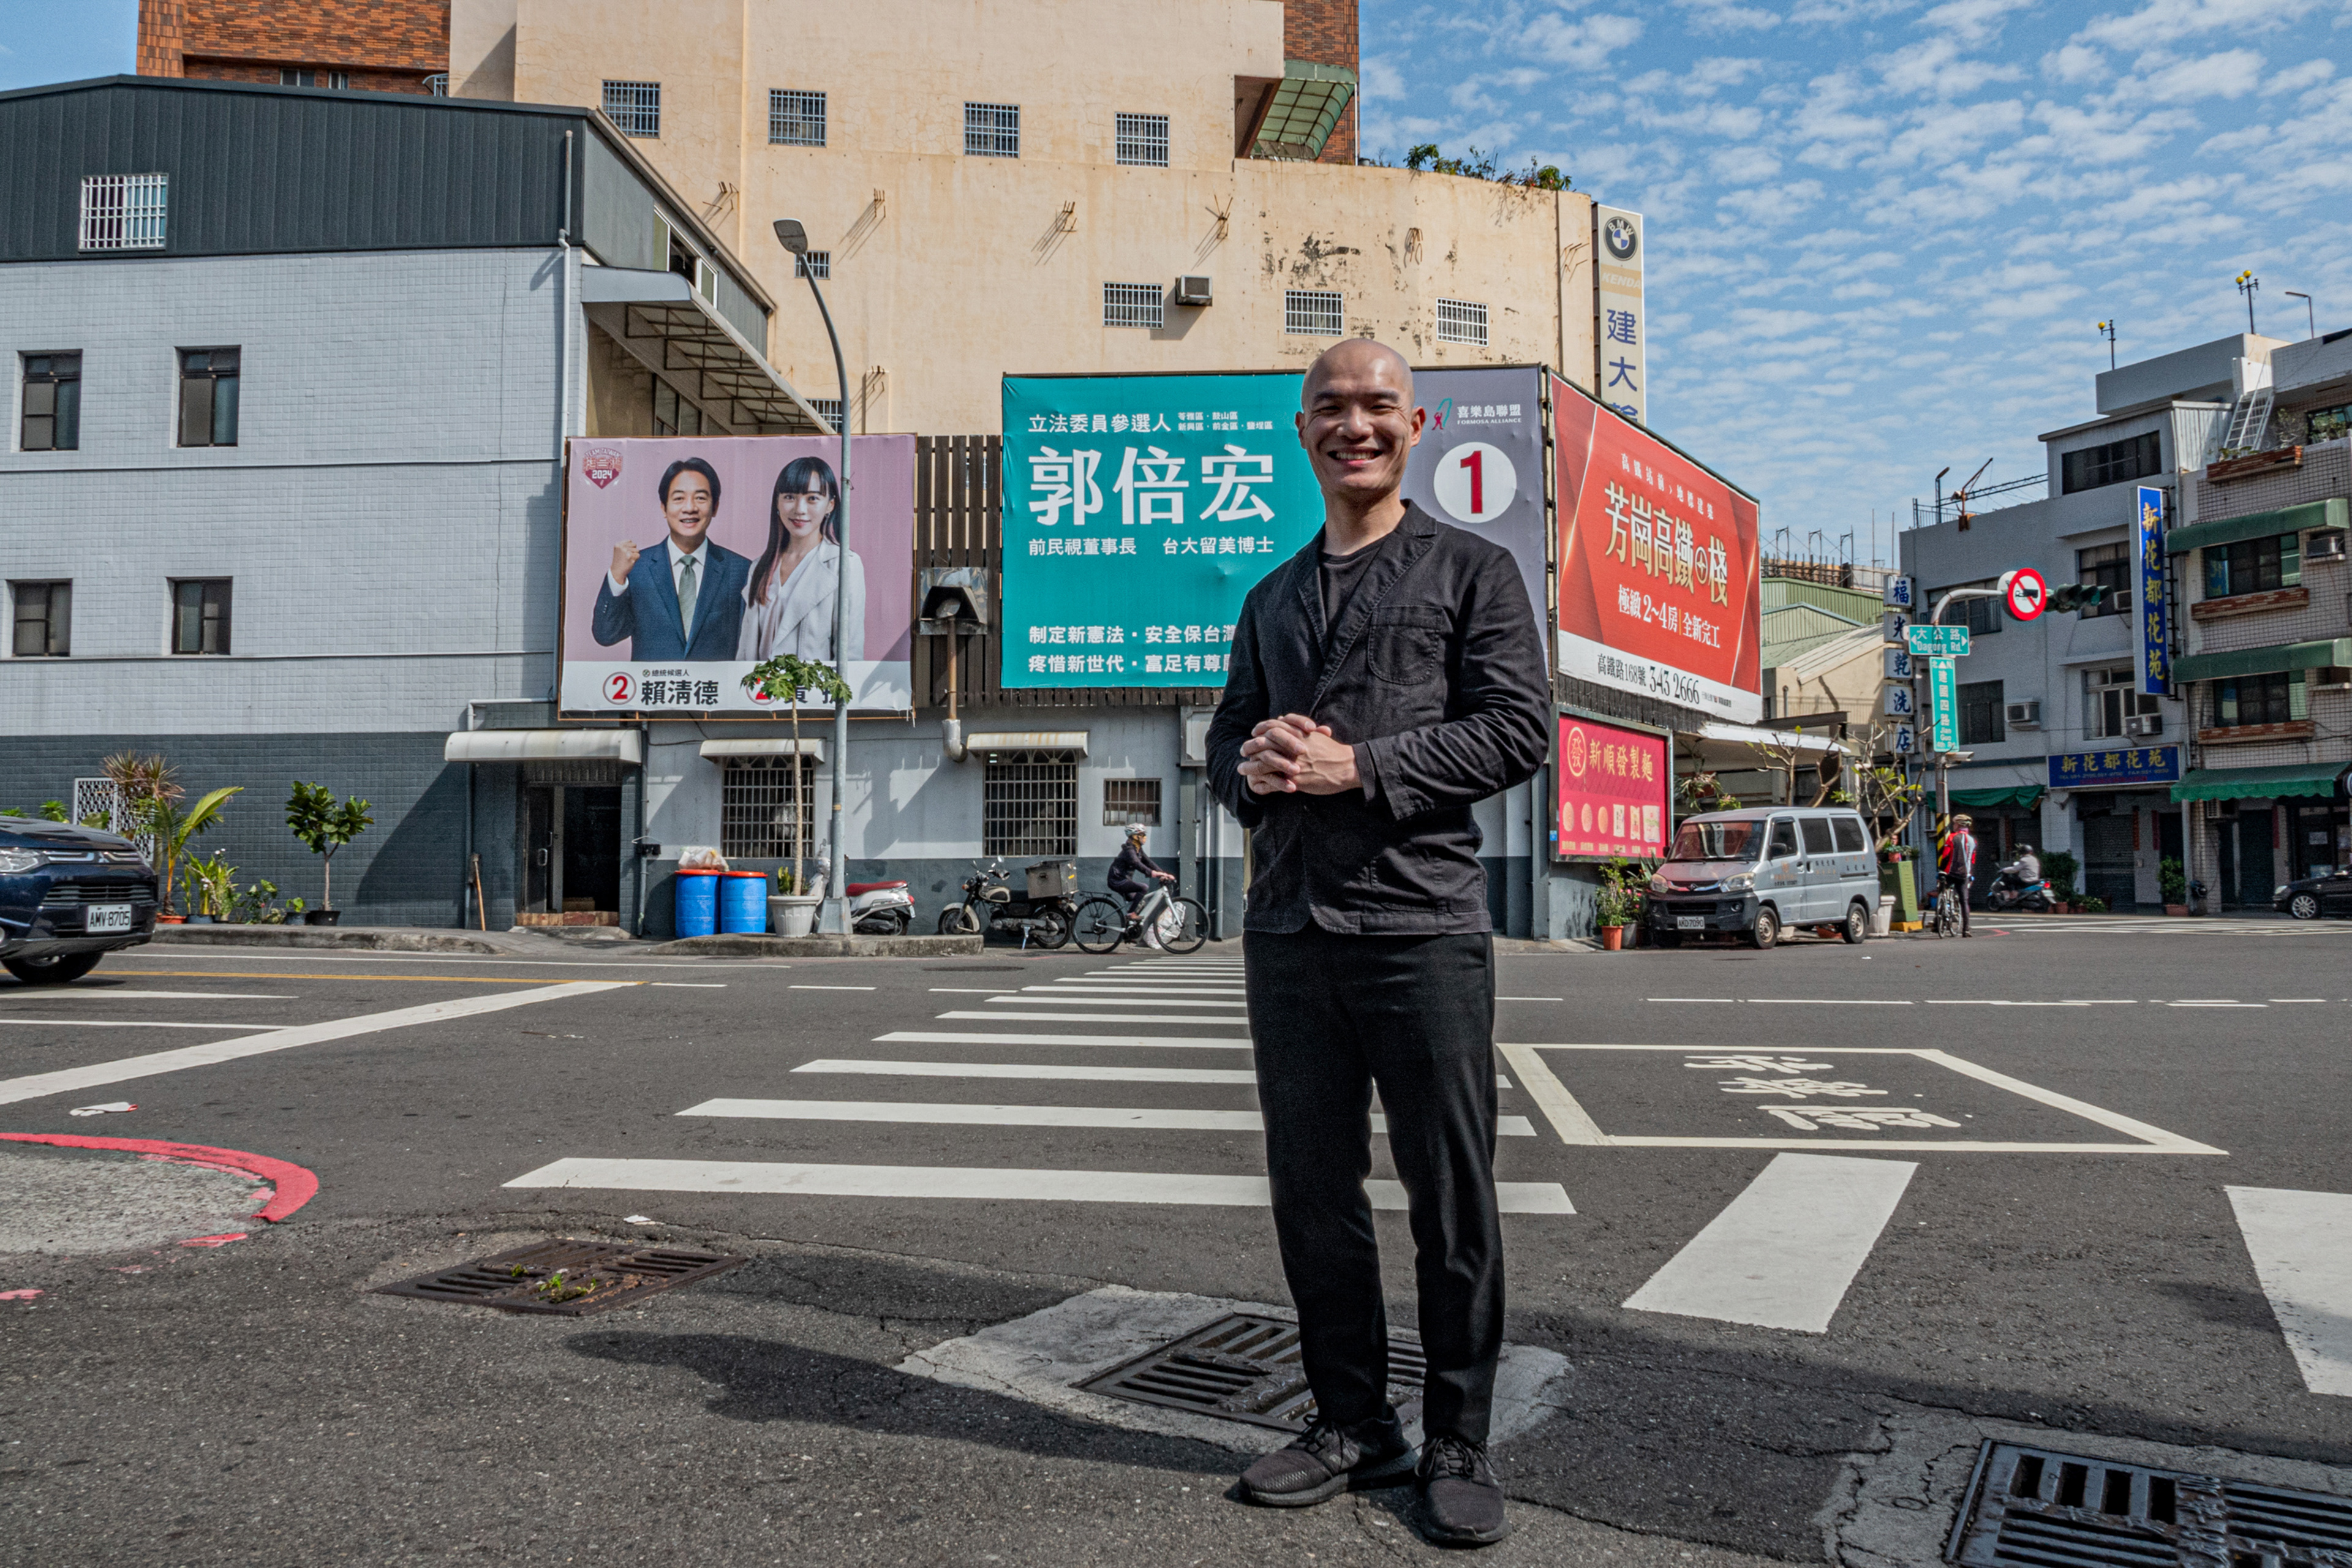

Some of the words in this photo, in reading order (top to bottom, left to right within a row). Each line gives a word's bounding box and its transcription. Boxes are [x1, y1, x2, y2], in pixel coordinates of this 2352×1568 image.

[1607, 218, 1634, 236] BMW
[1602, 271, 1642, 290] KENDA
[1457, 404, 1521, 418] 喜樂島聯盟
[1028, 413, 1171, 433] 立法委員參選人
[592, 470, 612, 479] 2024
[1460, 450, 1483, 514] 1
[1028, 443, 1275, 526] 郭倍宏
[1028, 538, 1137, 556] 前民視董事長
[1163, 537, 1274, 554] 台大留美博士
[2141, 502, 2165, 680] 新花都花苑
[1917, 628, 1961, 640] 大公路
[1917, 641, 1947, 654] Dagong
[612, 676, 628, 699] 2
[641, 680, 719, 705] 賴清德
[1673, 673, 1700, 704] 2666
[2061, 748, 2166, 773] 新花都花苑
[89, 911, 130, 927] AMV-8705
